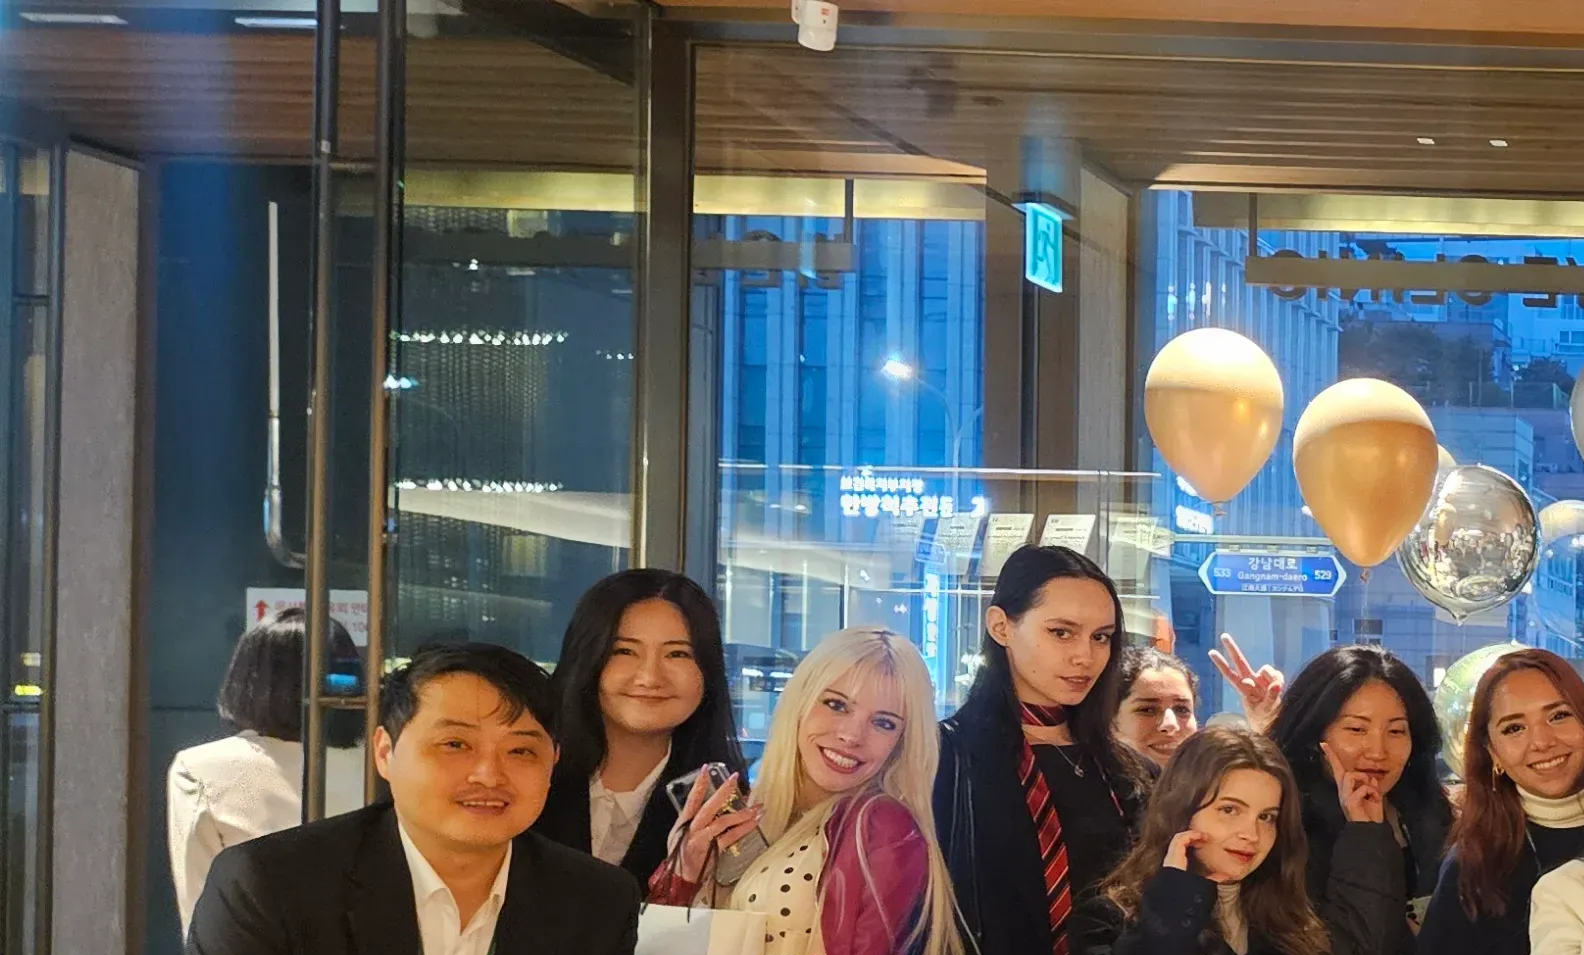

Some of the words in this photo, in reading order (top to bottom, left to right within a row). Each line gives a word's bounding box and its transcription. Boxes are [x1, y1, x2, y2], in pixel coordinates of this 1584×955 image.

[1248, 556, 1298, 571] 강남대로
[1213, 567, 1232, 578] 533
[1237, 571, 1308, 582] Gangnam-daero
[1314, 570, 1332, 580] 529
